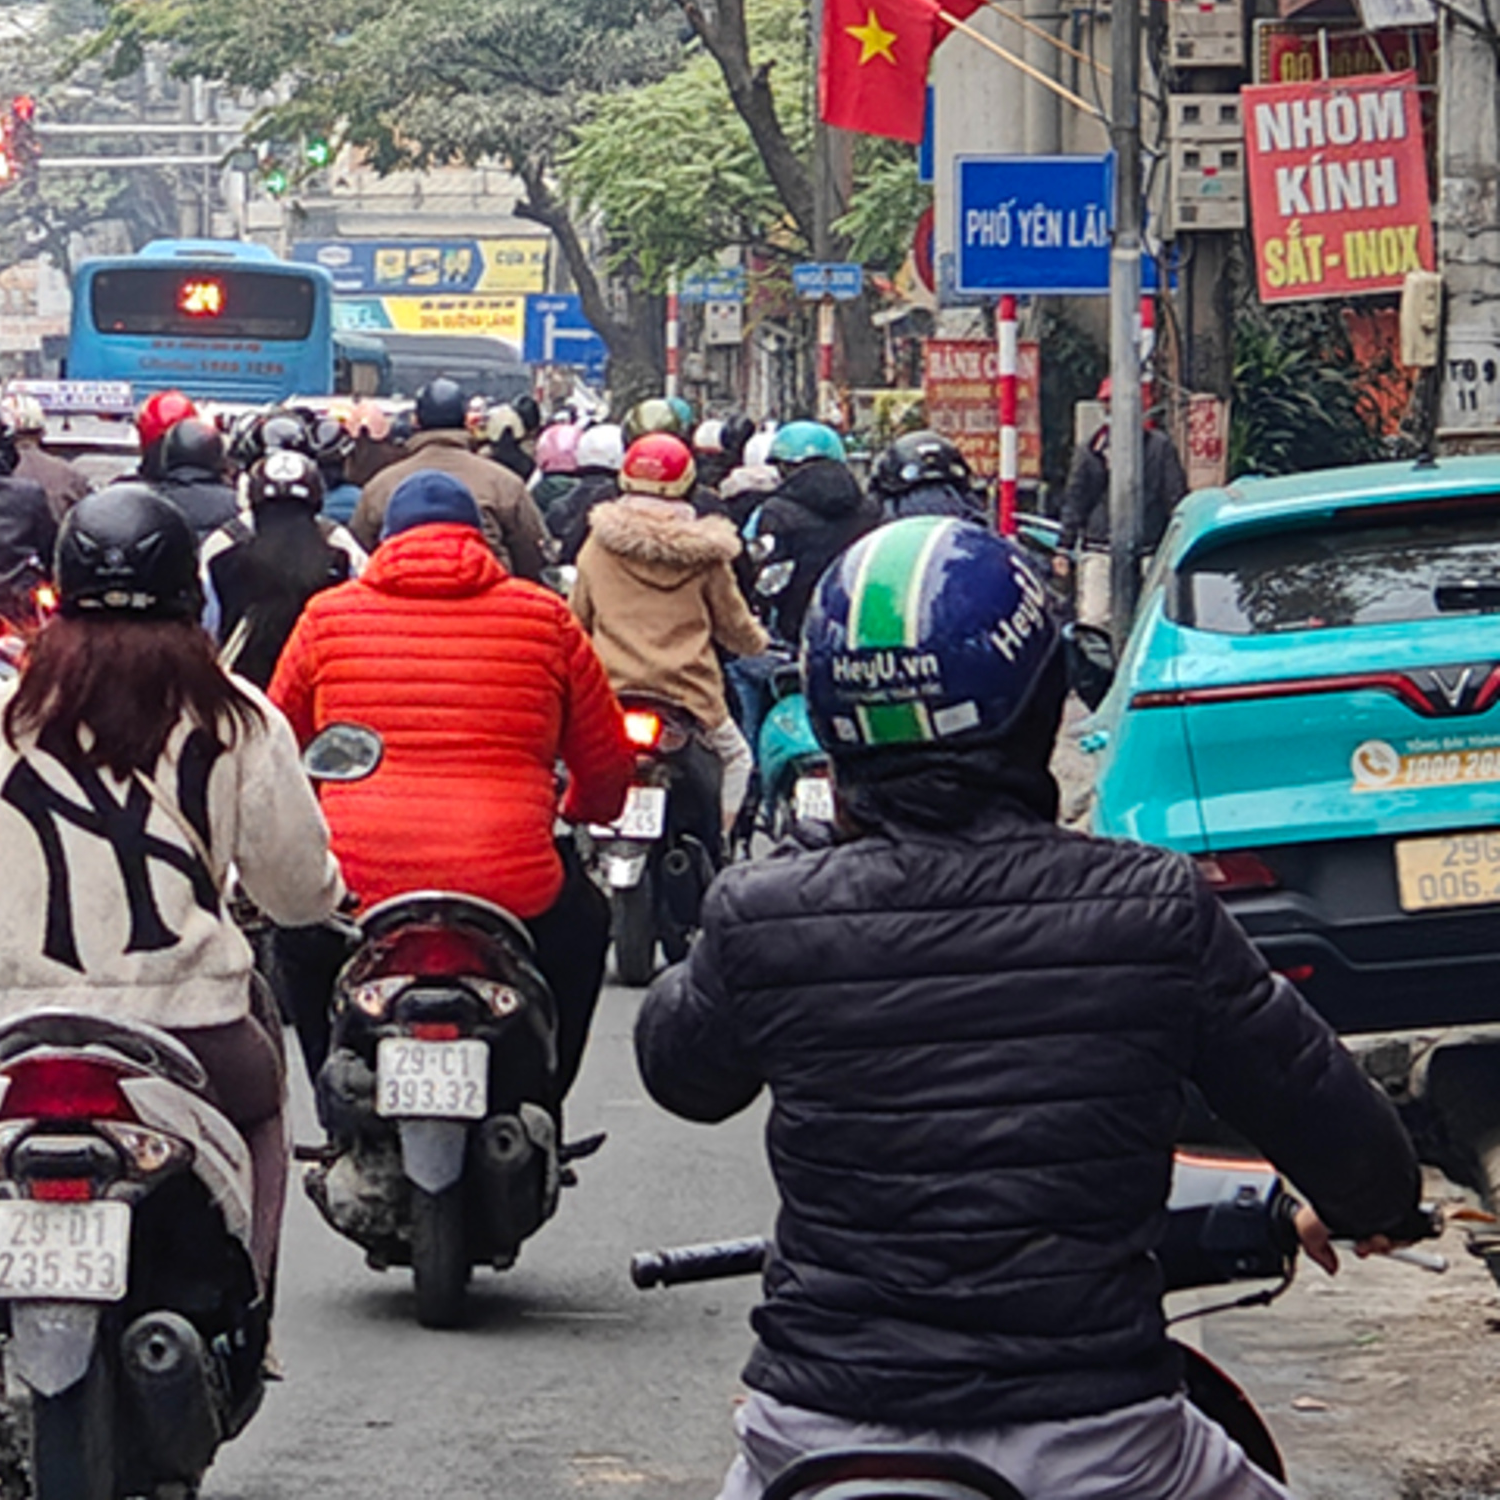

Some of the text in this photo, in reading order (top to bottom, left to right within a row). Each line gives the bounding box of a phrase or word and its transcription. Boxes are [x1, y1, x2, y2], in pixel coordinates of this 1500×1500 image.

[1275, 153, 1398, 217] KÍNH
[966, 197, 1018, 247] PHỐ
[1018, 202, 1063, 248] YÊN
[989, 555, 1044, 662] HeyU
[833, 652, 940, 687] HeyU.vn
[1406, 754, 1460, 783] 1900
[386, 1078, 478, 1110] 393.32
